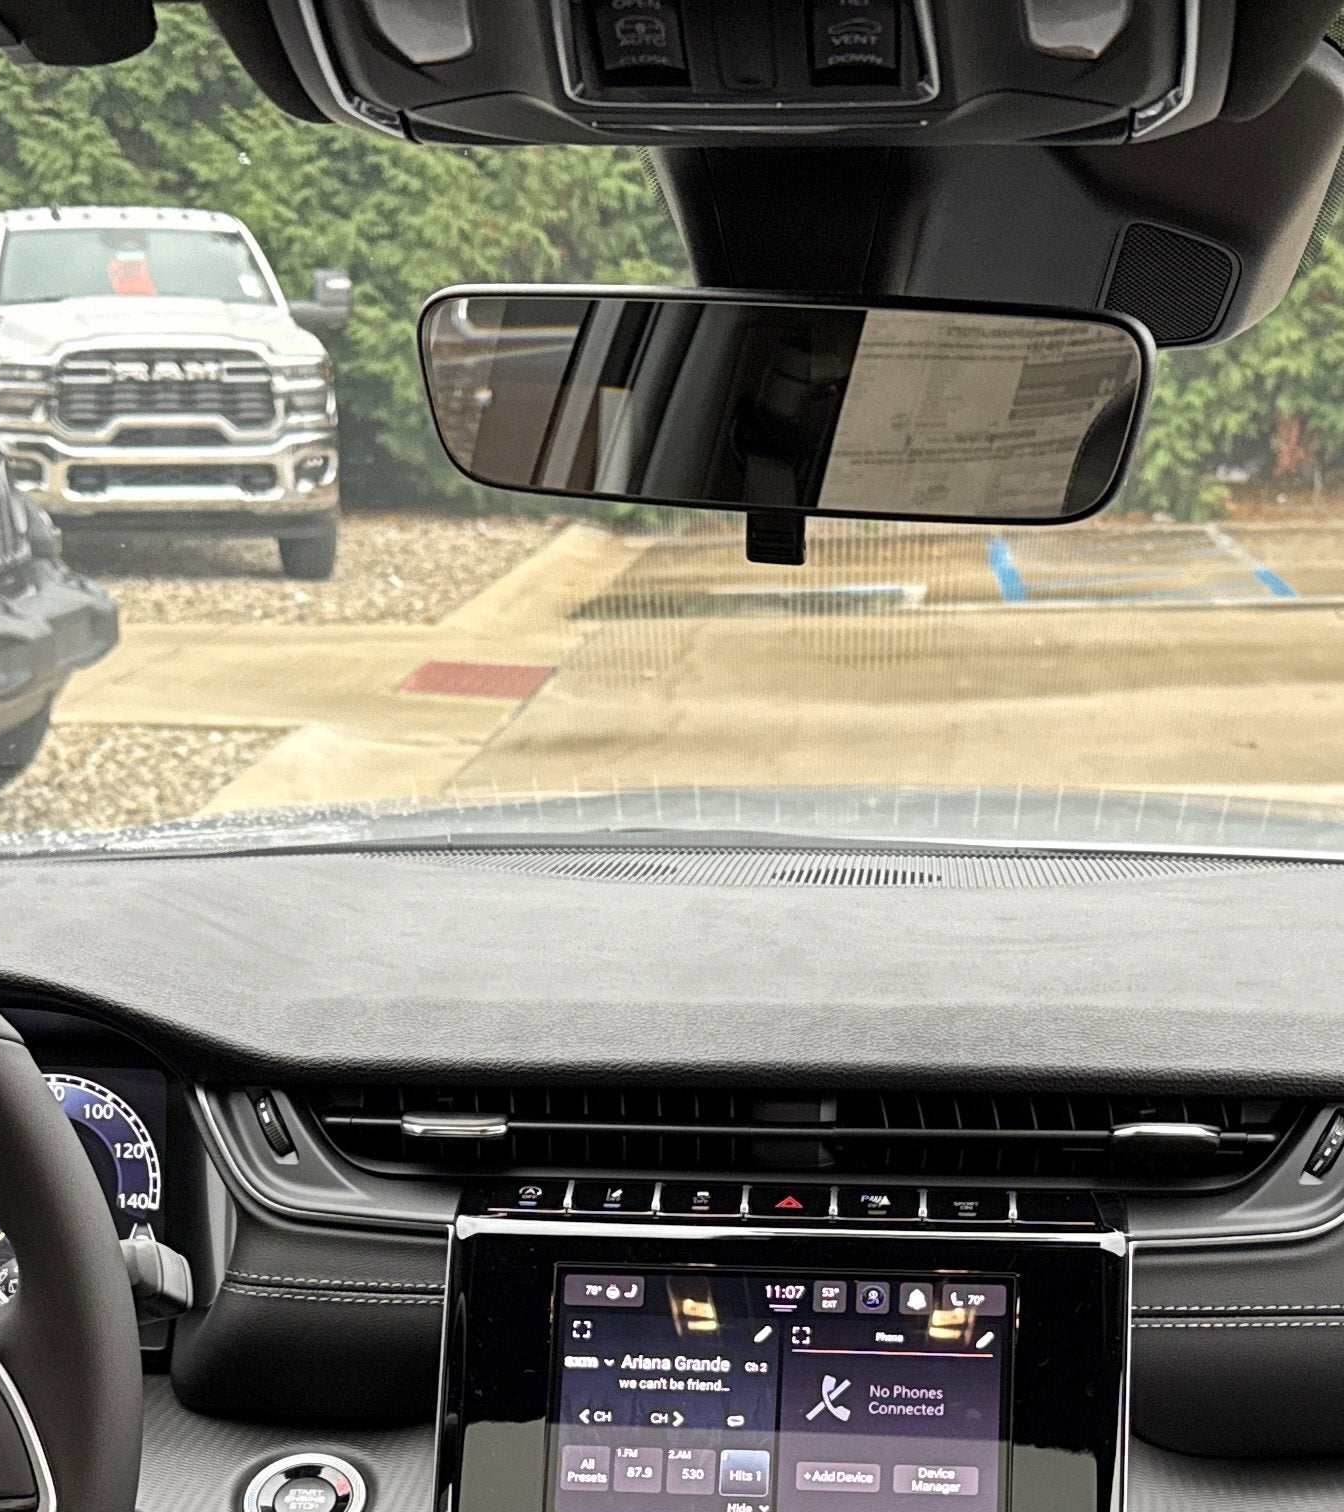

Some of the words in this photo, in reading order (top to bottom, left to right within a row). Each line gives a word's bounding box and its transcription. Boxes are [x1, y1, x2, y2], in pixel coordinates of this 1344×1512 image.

[830, 35, 878, 47] VENT
[112, 361, 220, 382] RAM
[83, 1103, 115, 1120] 100
[114, 1143, 145, 1159] 120
[117, 1193, 150, 1209] 140
[765, 1284, 806, 1300] 11:07
[821, 1300, 838, 1309] EXT
[875, 1332, 905, 1343] Phone
[620, 1354, 672, 1371] Ariana
[674, 1355, 732, 1373] Grande
[744, 1361, 758, 1373] Ch
[759, 1362, 769, 1373] 2
[618, 1379, 638, 1390] we
[639, 1377, 669, 1390] can't
[669, 1378, 685, 1391] be
[869, 1384, 890, 1398] No
[893, 1385, 944, 1400] Phones
[868, 1401, 945, 1417] Connected
[593, 1411, 613, 1423] CH
[649, 1412, 669, 1424] CH
[580, 1458, 595, 1470] All
[567, 1472, 608, 1484] Presets
[626, 1466, 653, 1479] 87.9
[681, 1468, 705, 1480] 530
[729, 1470, 754, 1482] Hits
[811, 1470, 836, 1483] Add
[836, 1471, 874, 1484] Device
[917, 1467, 956, 1480] Device
[911, 1480, 962, 1495] Manager
[288, 1502, 320, 1510] STOP
